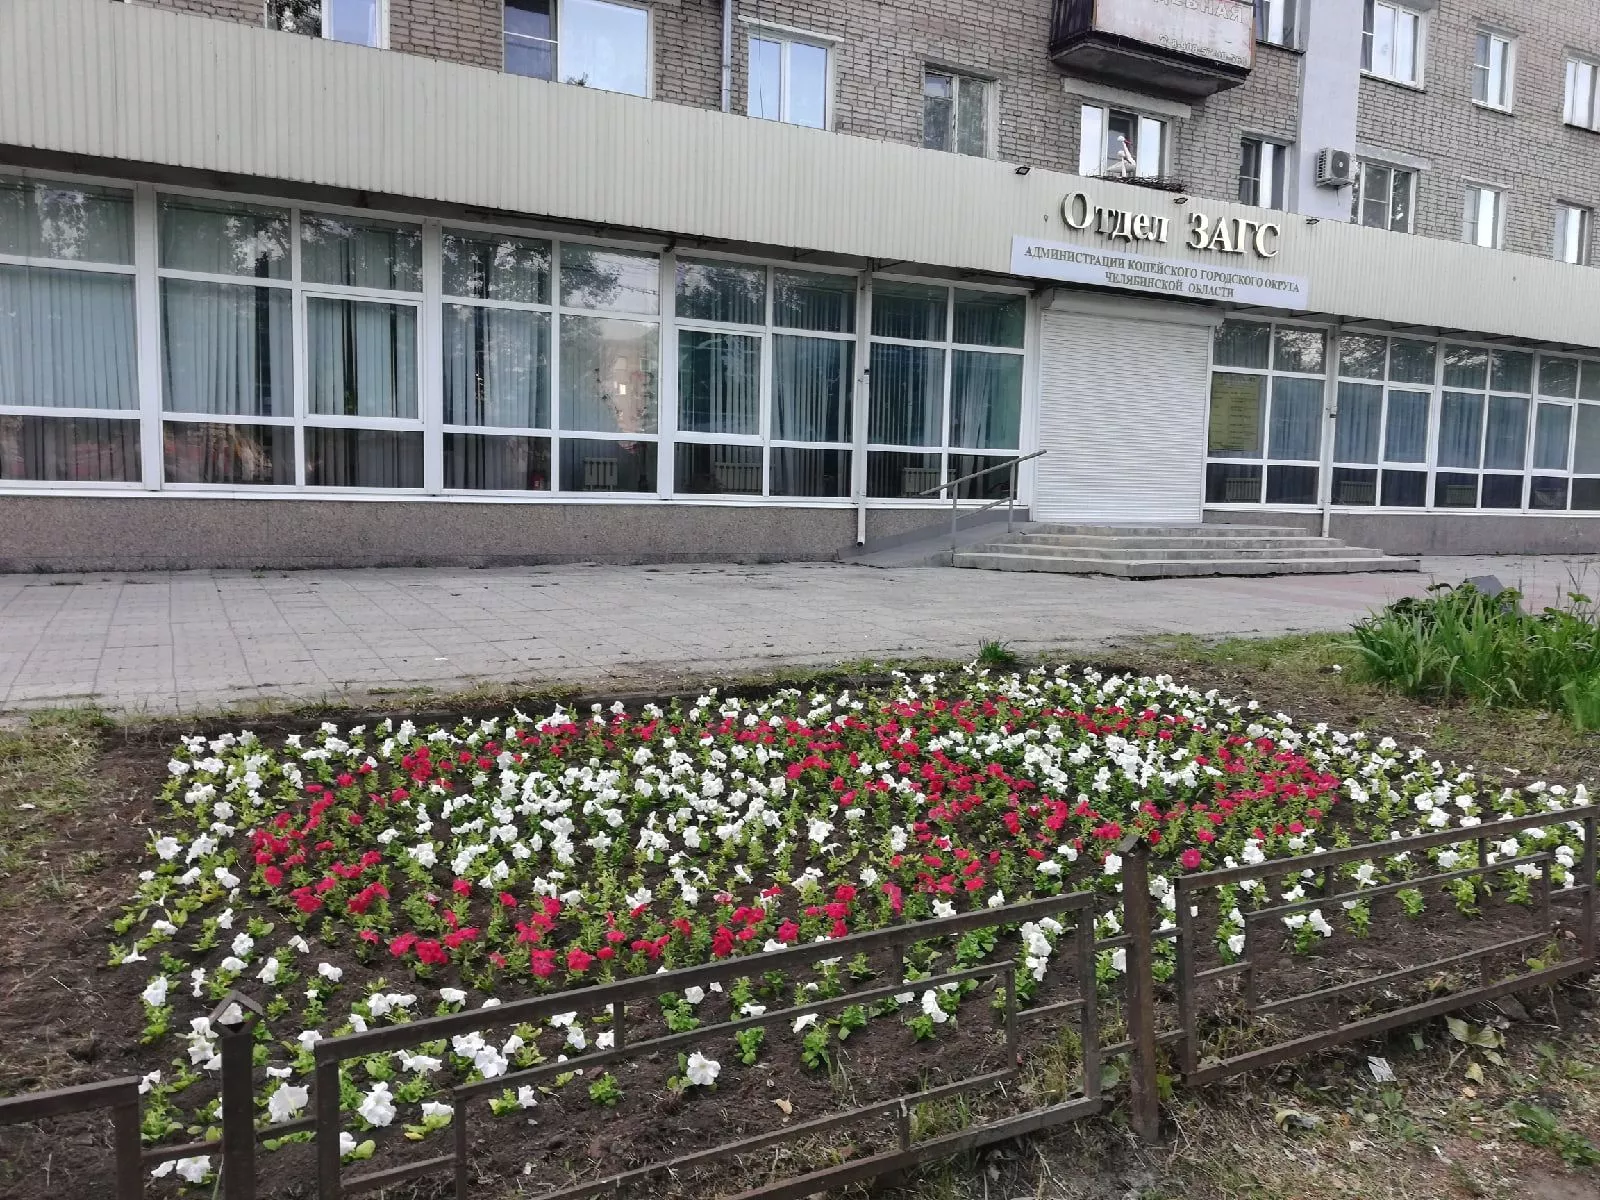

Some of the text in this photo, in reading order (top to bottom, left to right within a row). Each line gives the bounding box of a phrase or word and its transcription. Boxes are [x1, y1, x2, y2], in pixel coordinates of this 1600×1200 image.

[1061, 192, 1280, 258] Отдел ЗАГС
[1024, 246, 1300, 293] АДМИНИСТРАЦИИ КОПЕЙСКОГО ГОРОДСКОГО ОКРУГА
[1105, 272, 1234, 298] ЧЕЛЯБИНСКОЙ ОБЛАСТИ
